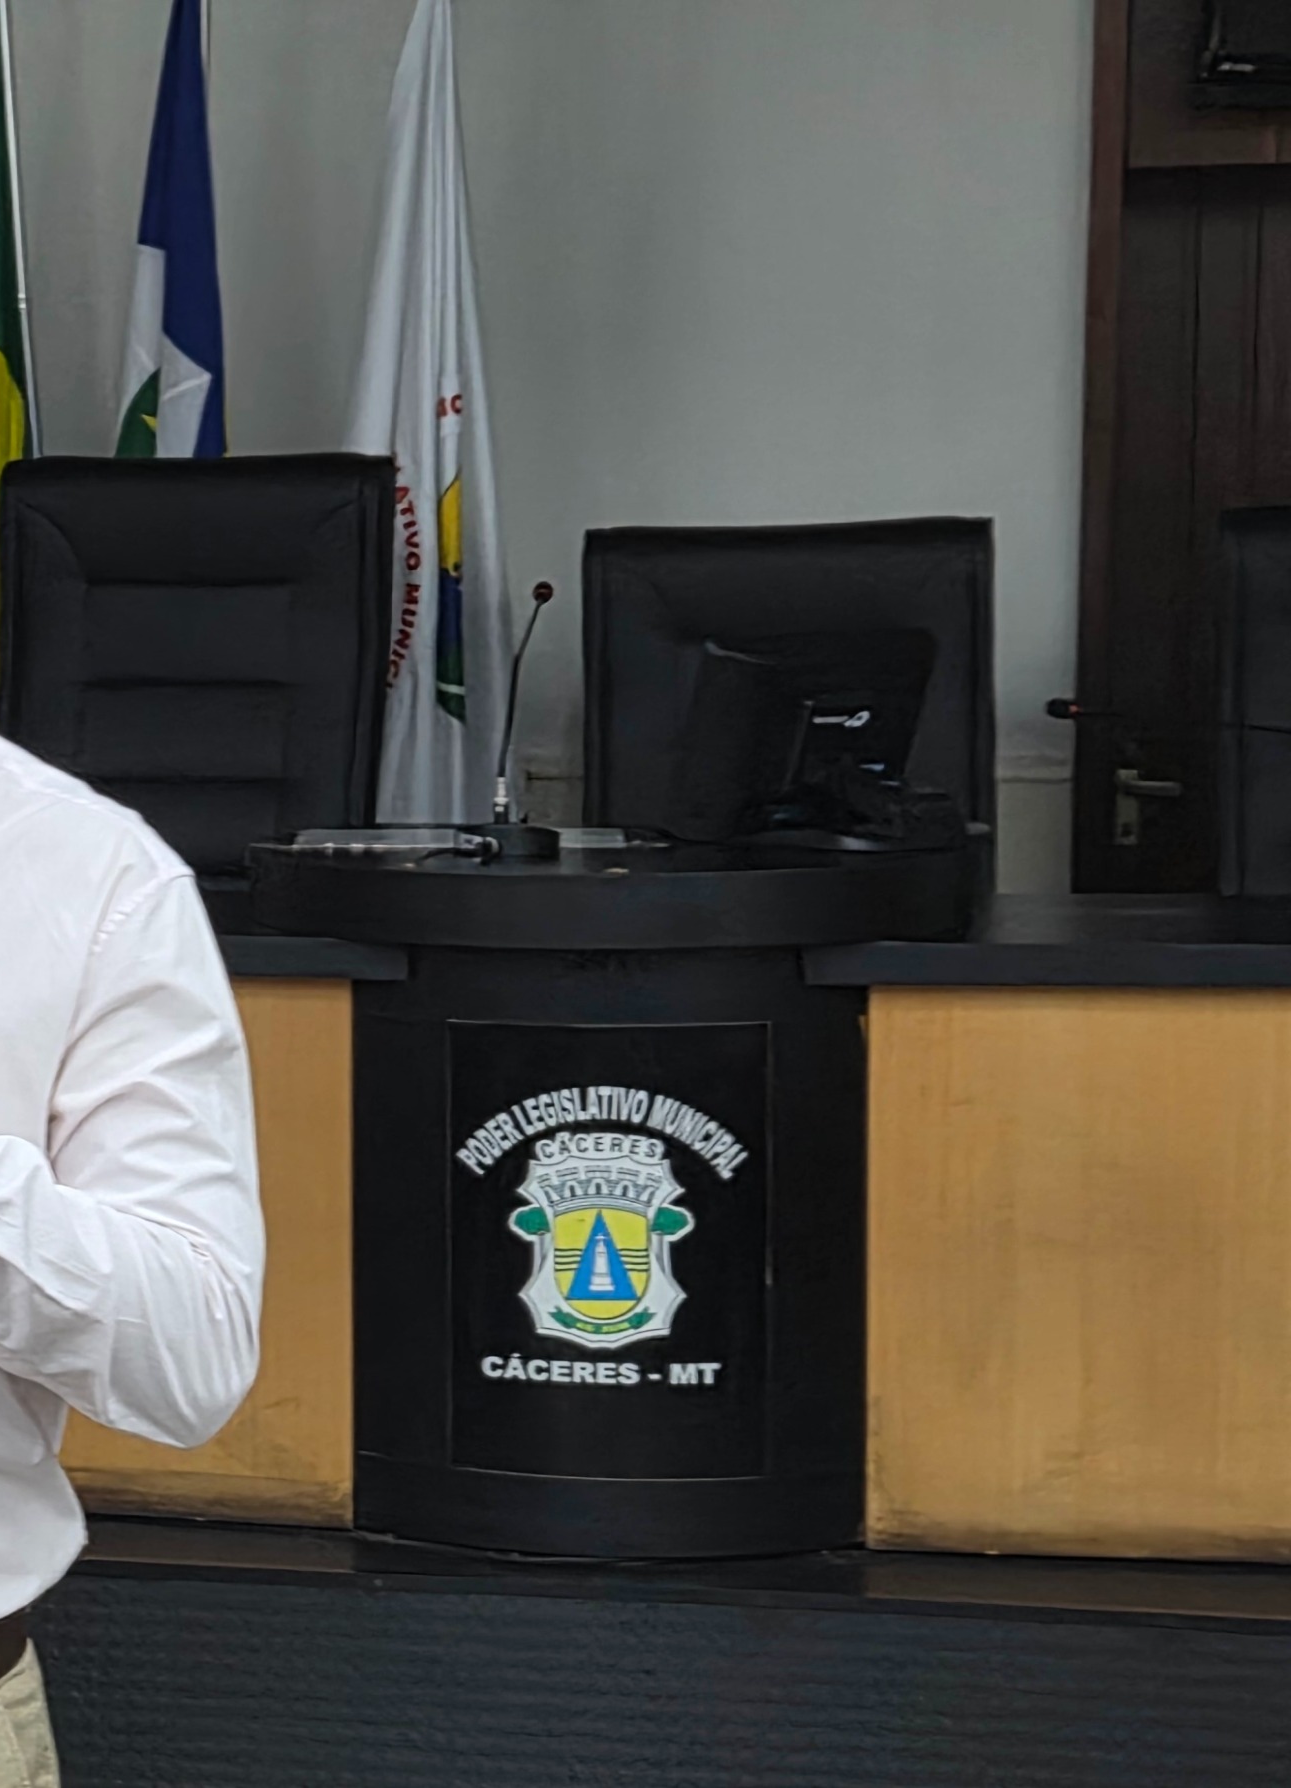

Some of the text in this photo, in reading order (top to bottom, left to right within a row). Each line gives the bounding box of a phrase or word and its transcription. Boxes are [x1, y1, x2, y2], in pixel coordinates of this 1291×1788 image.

[455, 1085, 749, 1180] PODER LEGISLATIVO MUNICIPAL
[481, 1352, 641, 1386] CÁCERES
[669, 1362, 721, 1385] MT
